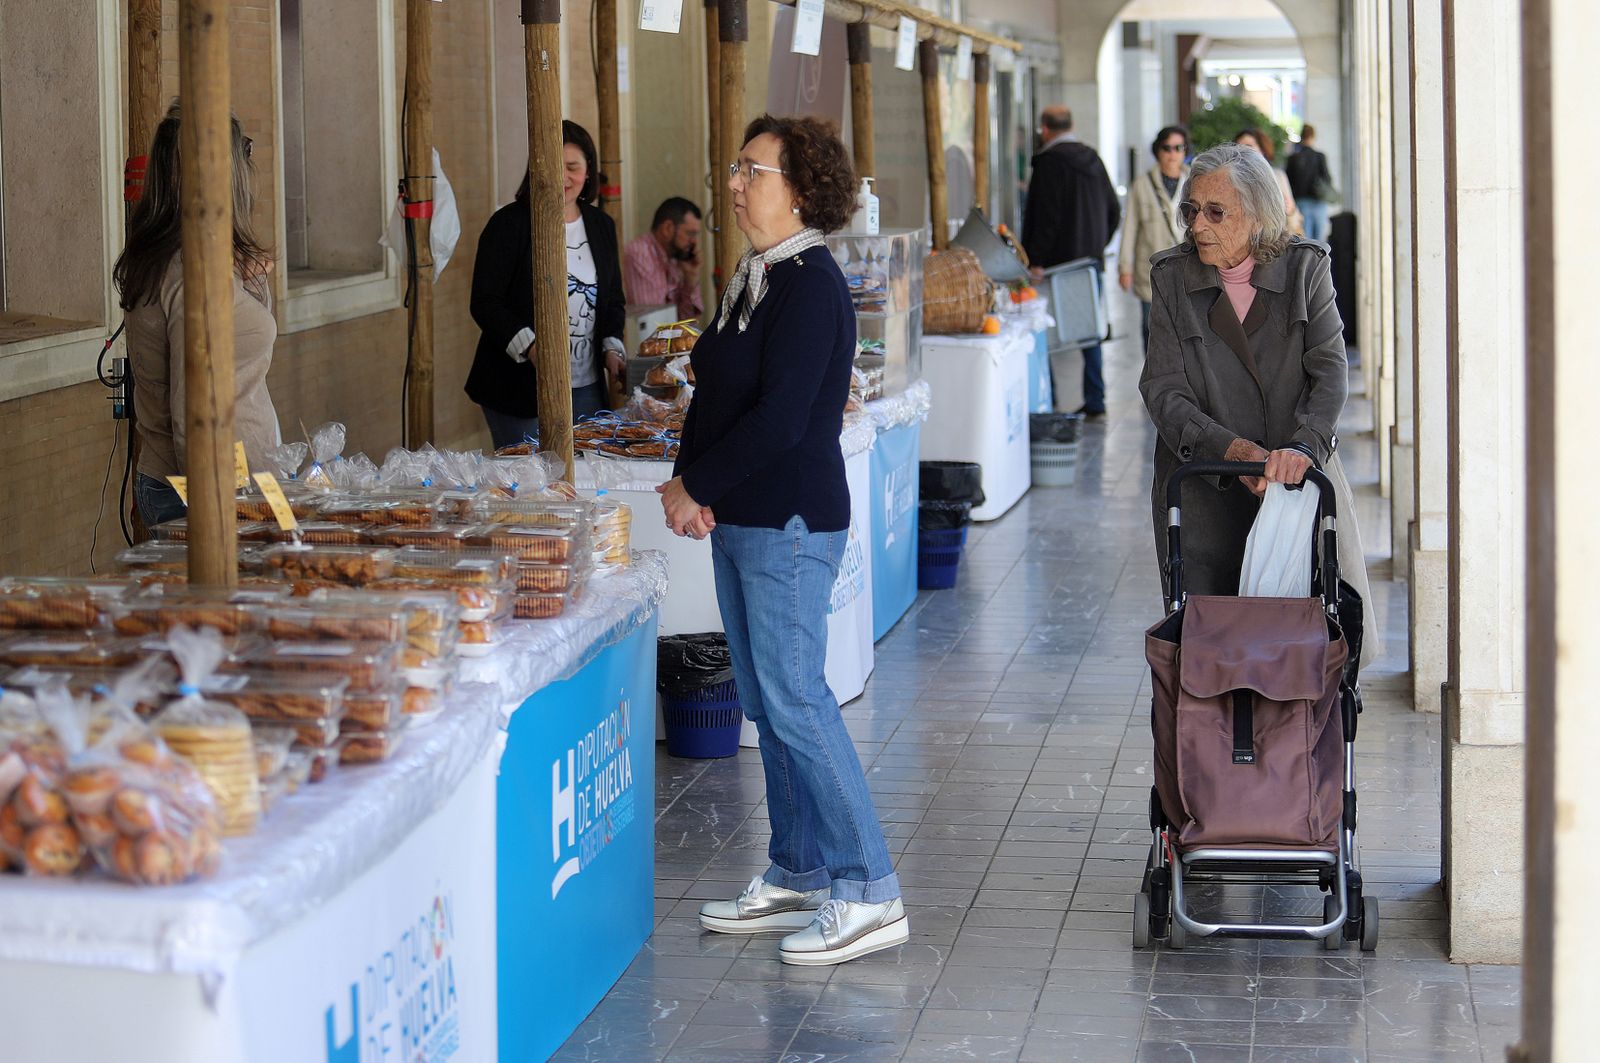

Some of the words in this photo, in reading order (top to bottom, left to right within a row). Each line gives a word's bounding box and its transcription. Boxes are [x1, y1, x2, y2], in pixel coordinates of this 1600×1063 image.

[577, 687, 631, 784] DIPUTACIÓN
[577, 784, 592, 835] DE
[595, 747, 632, 818] HUELVA
